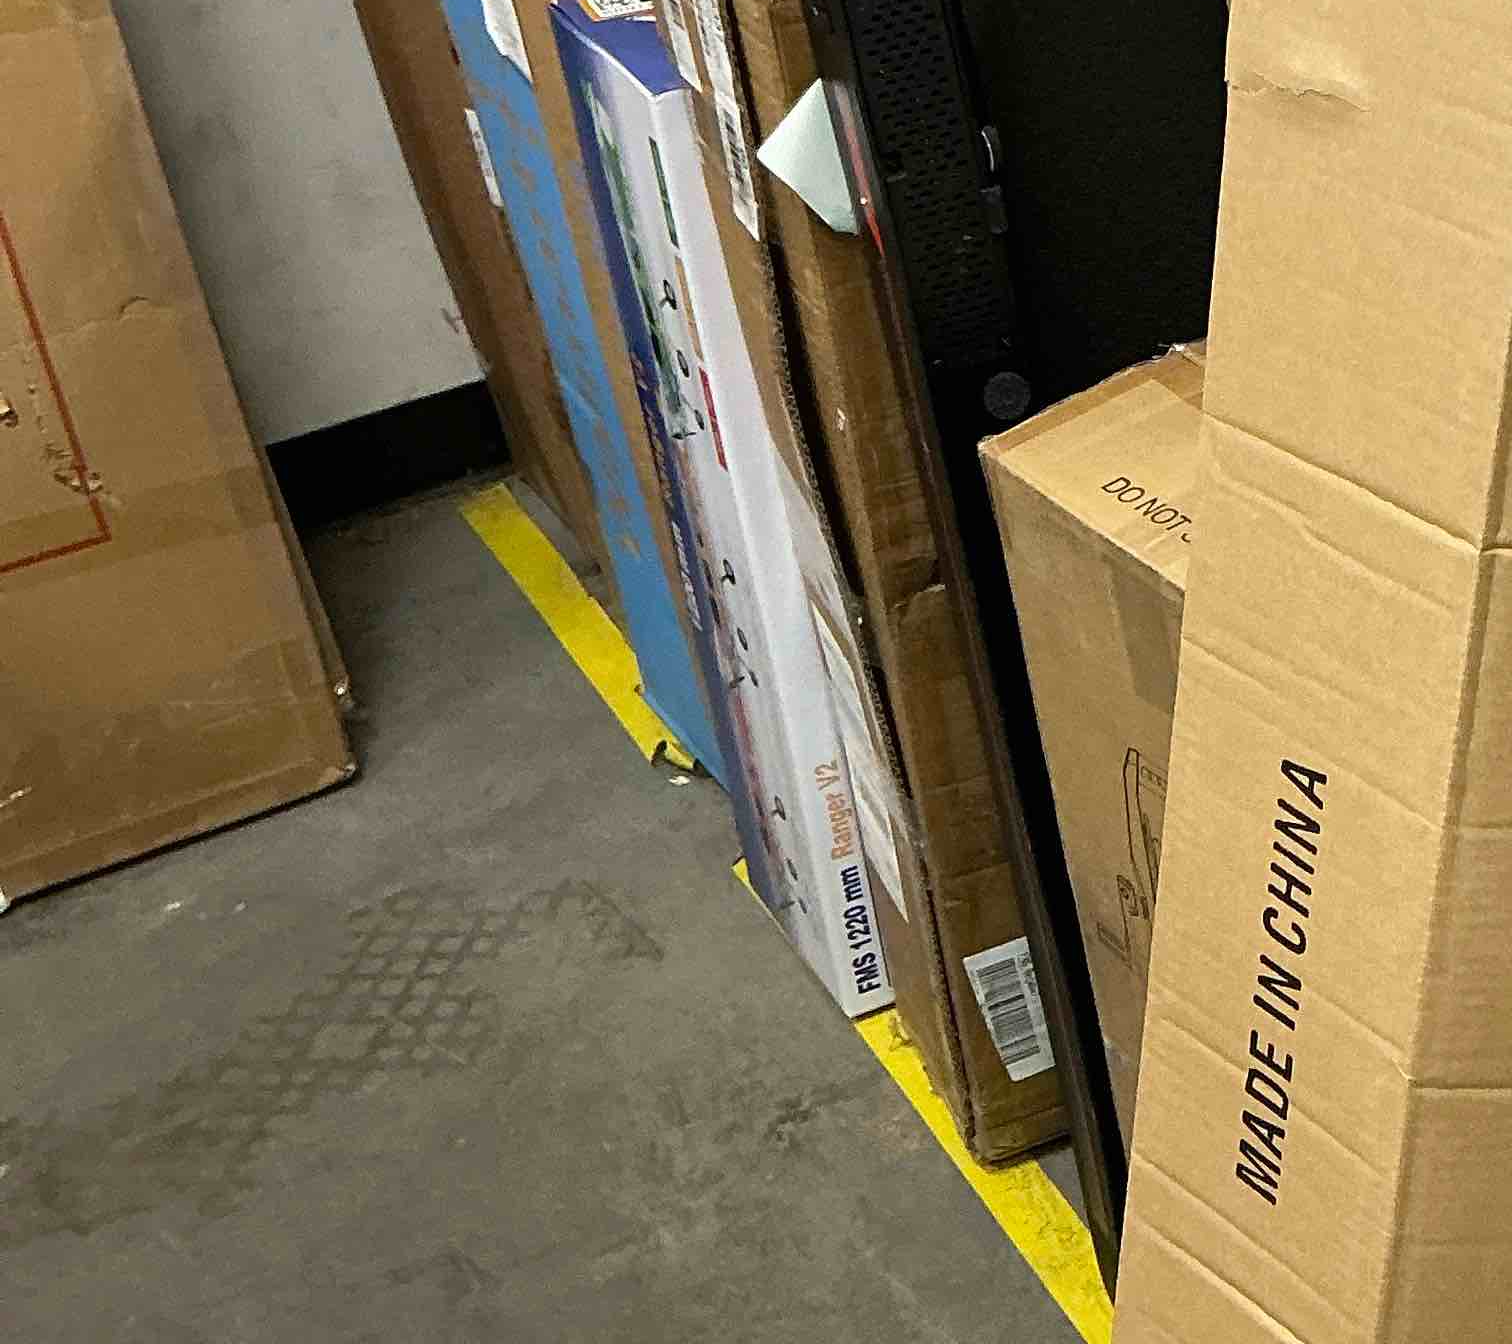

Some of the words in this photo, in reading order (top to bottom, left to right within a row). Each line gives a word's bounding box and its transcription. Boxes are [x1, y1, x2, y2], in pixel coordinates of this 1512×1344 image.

[1101, 477, 1145, 503] DO
[1134, 497, 1192, 531] NOT
[814, 759, 841, 791] V2
[825, 792, 855, 861] Ranger
[1261, 757, 1329, 955] CHINA
[840, 864, 864, 903] mm
[844, 904, 873, 950] 1220
[853, 950, 882, 995] FMS
[1252, 953, 1303, 1031] IN
[1235, 1029, 1295, 1206] MADE
